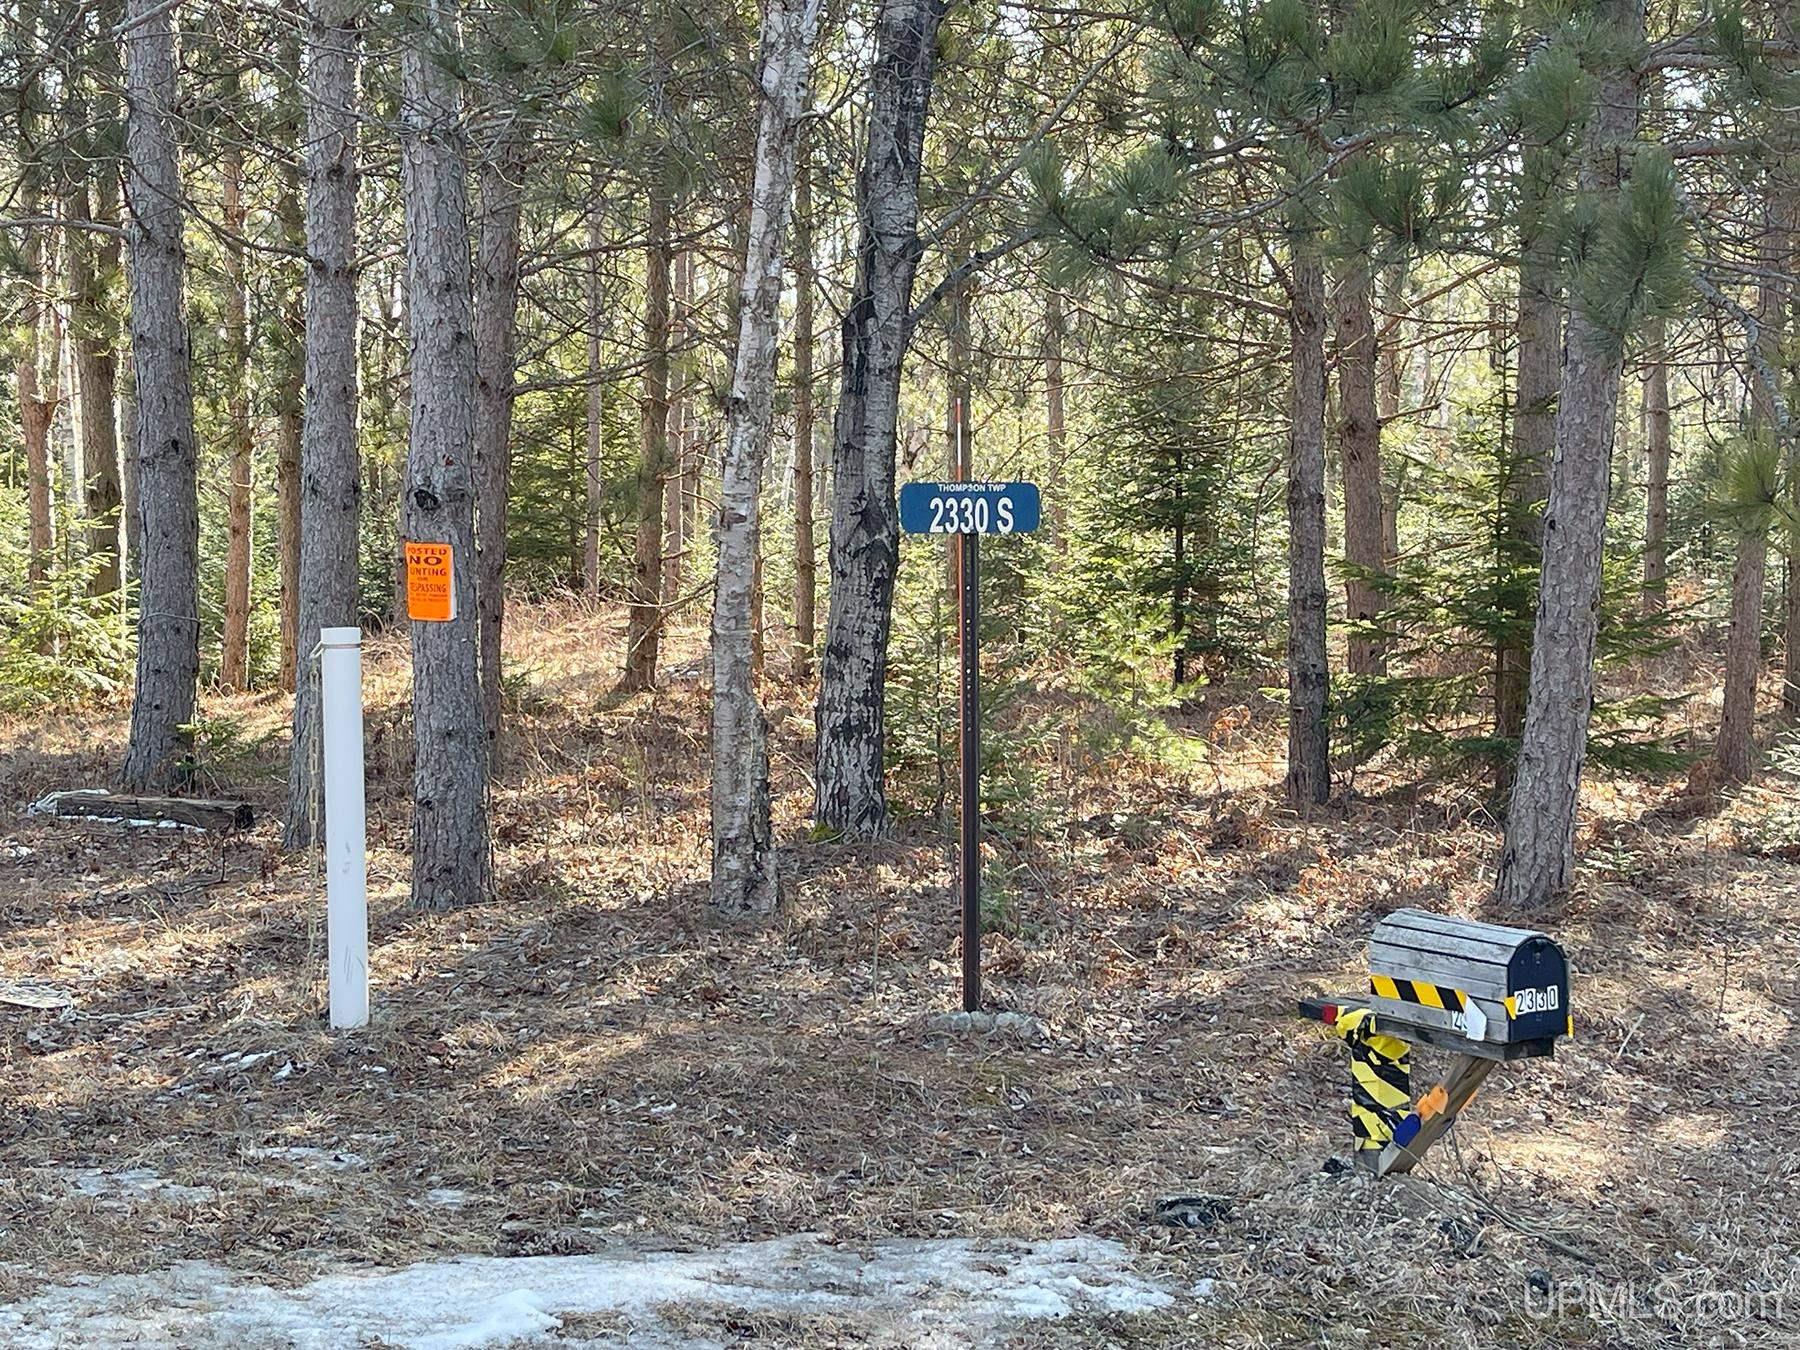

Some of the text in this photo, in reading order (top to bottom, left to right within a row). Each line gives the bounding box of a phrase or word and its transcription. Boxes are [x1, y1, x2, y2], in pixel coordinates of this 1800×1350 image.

[938, 484, 1007, 493] THOMPSON TWP
[929, 497, 1014, 534] 2330 S
[409, 555, 442, 566] NO
[409, 567, 447, 576] UNTING
[1516, 987, 1557, 1013] 2330
